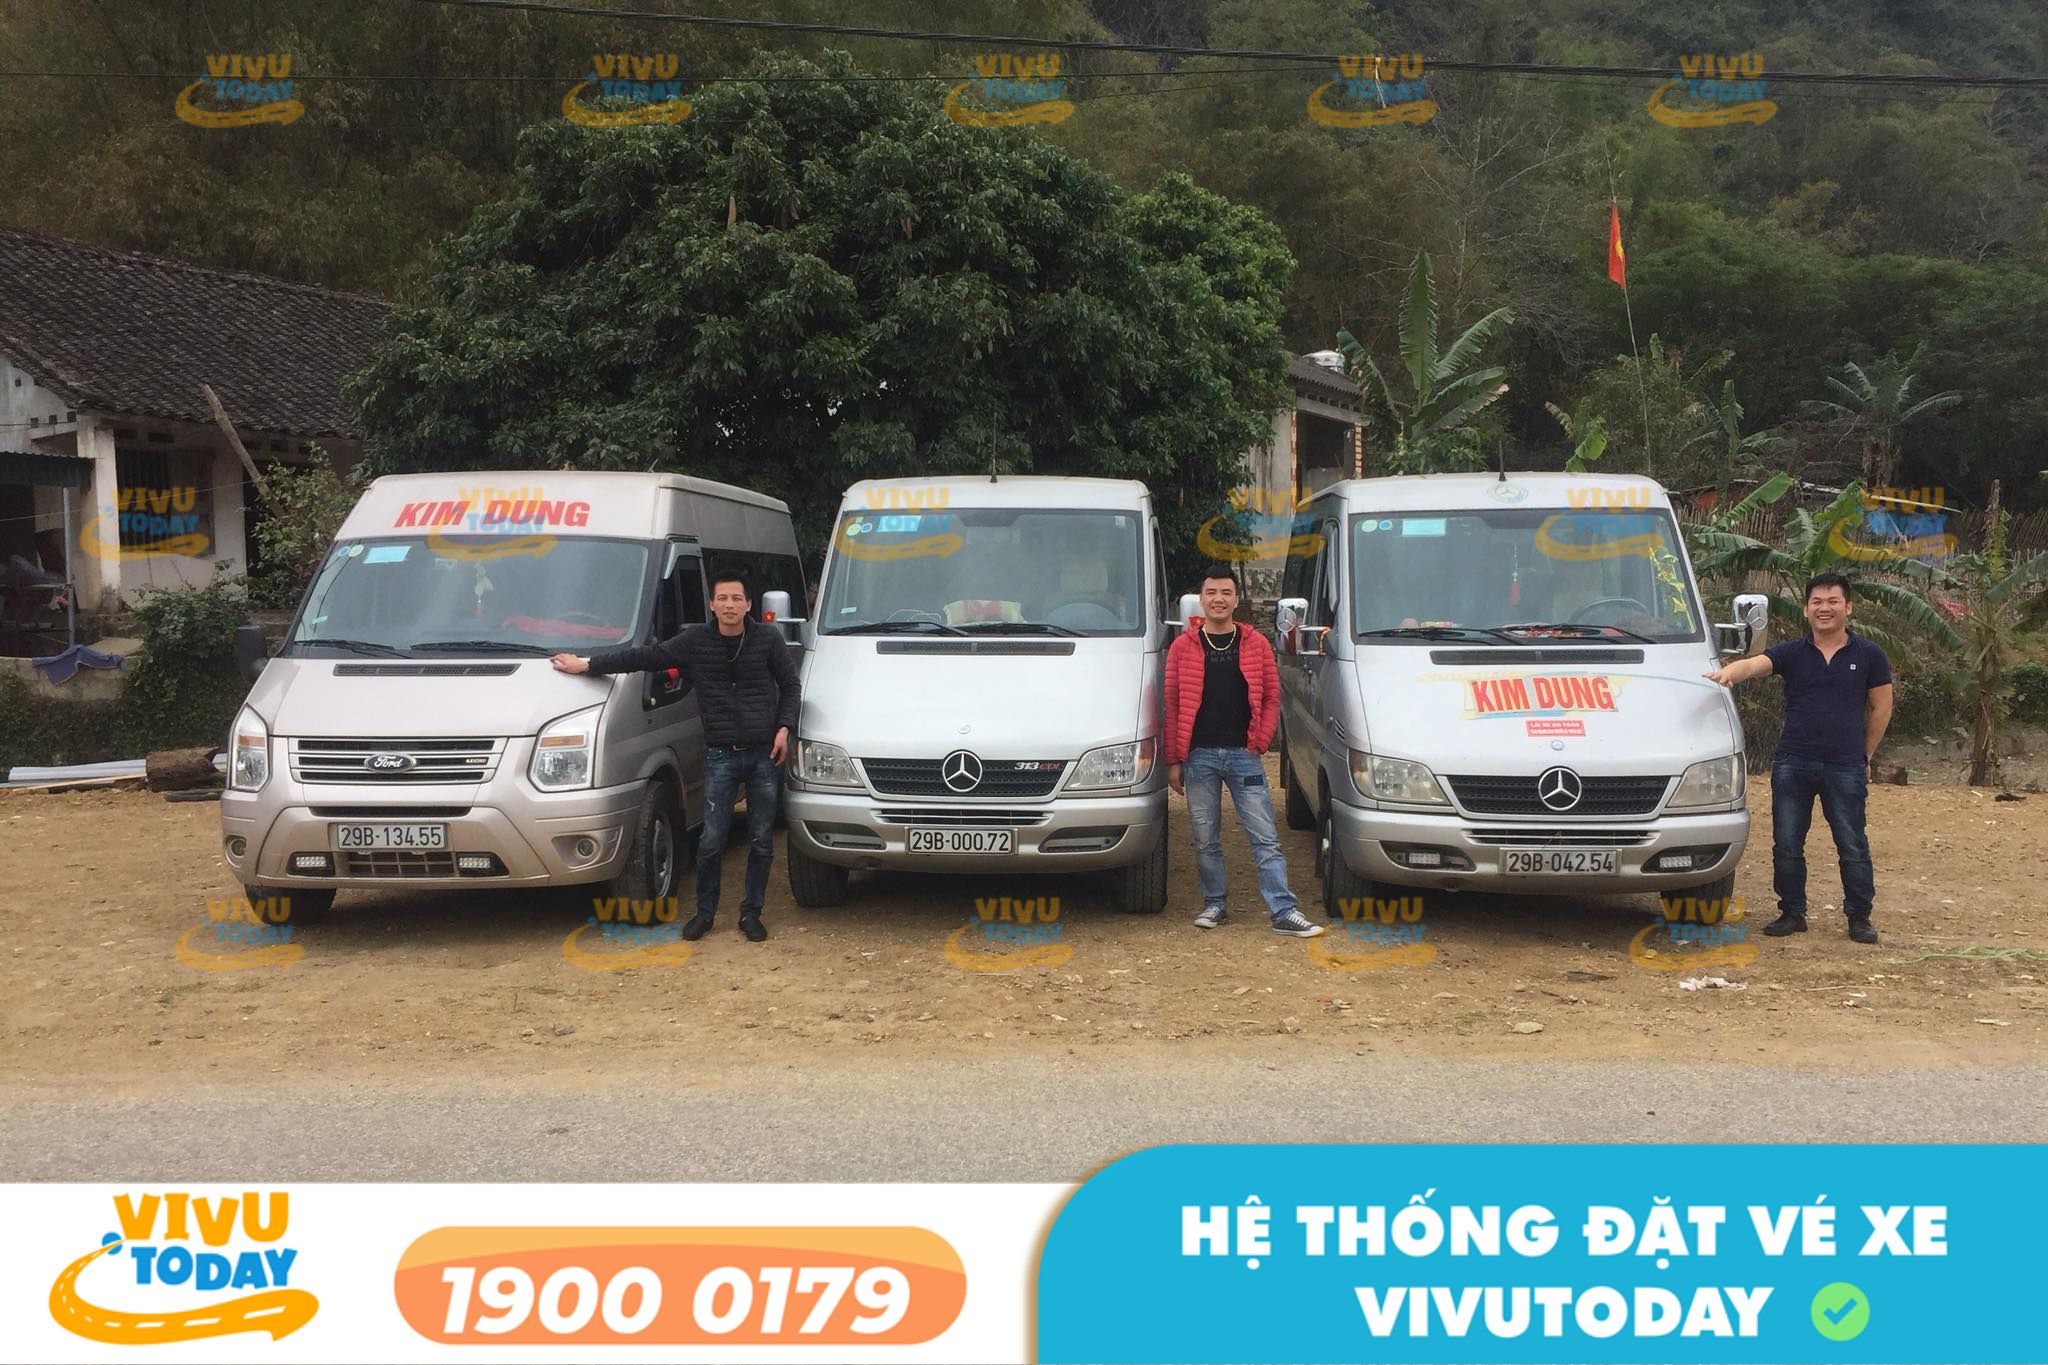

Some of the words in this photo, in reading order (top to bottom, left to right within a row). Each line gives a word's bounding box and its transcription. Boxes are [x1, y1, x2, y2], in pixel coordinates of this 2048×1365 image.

[393, 500, 470, 528] KIM
[483, 499, 590, 527] DUNG
[1471, 677, 1531, 713] KIM
[1532, 675, 1616, 711] DUNG
[373, 756, 403, 768] Ford
[341, 826, 442, 847] 29B-134.55
[912, 831, 1009, 851] 29B-000.72
[1508, 852, 1613, 872] 29B-042.54
